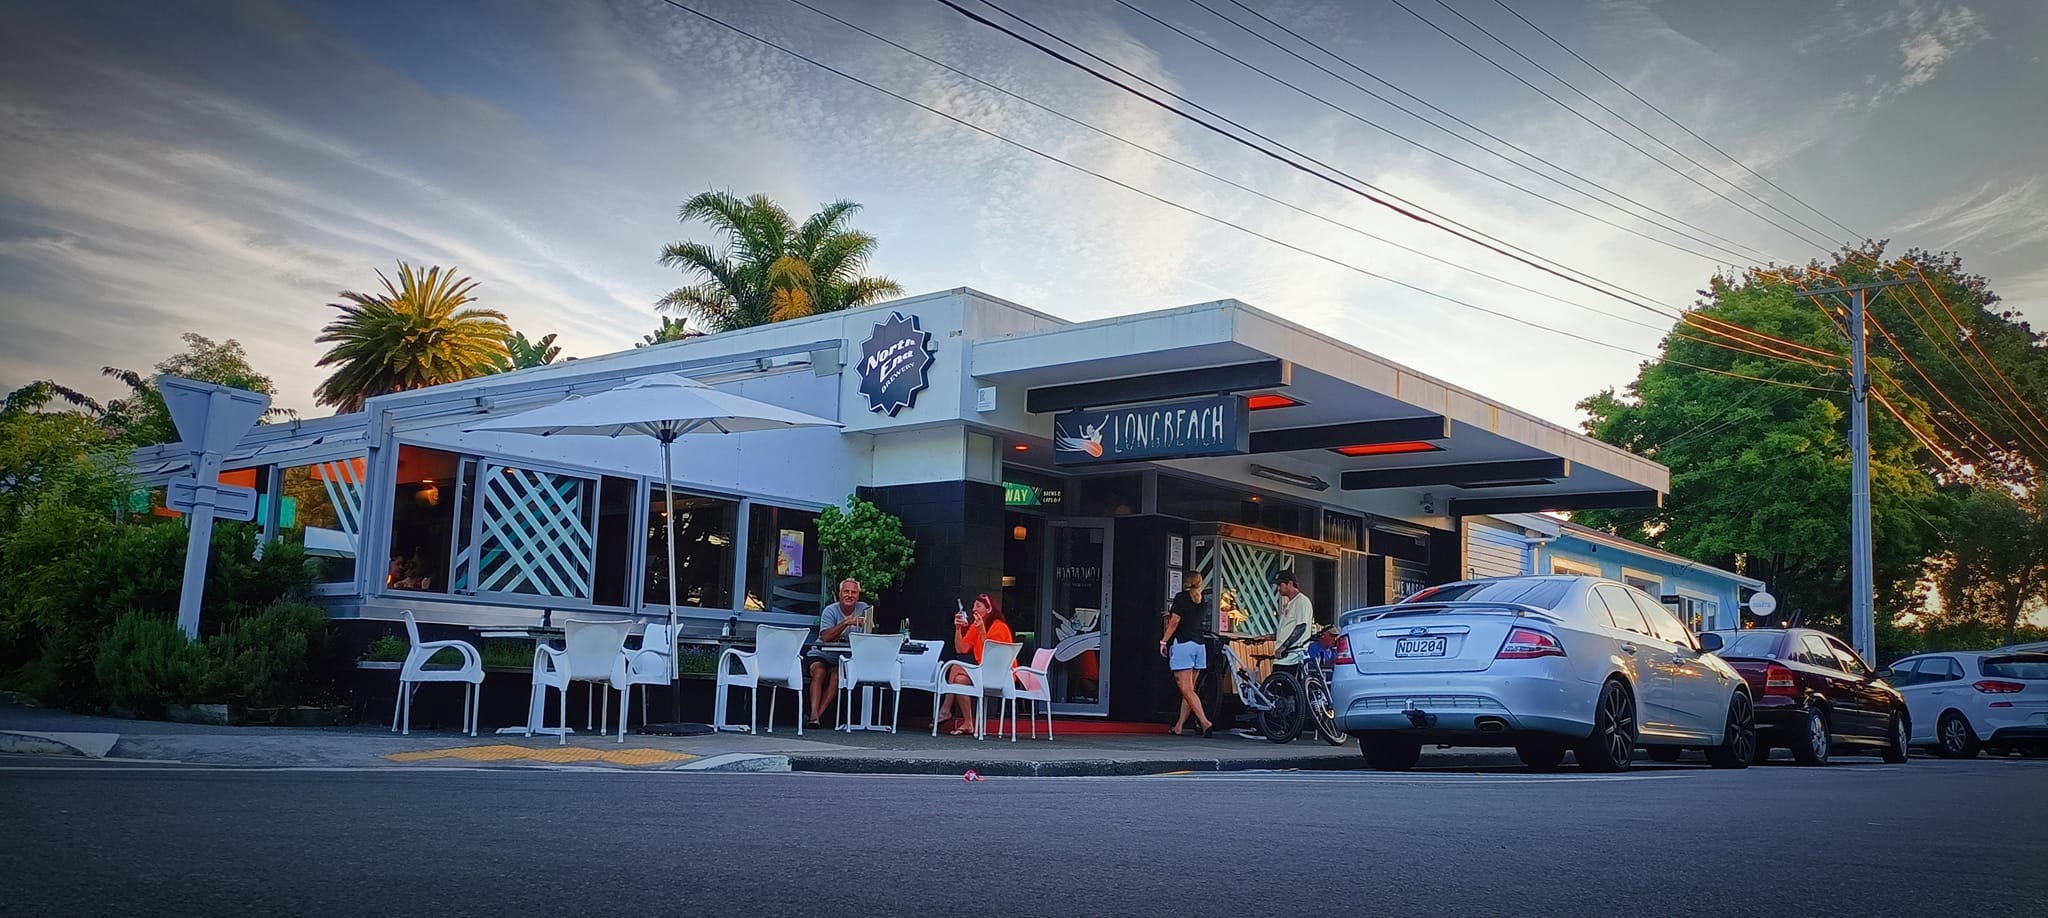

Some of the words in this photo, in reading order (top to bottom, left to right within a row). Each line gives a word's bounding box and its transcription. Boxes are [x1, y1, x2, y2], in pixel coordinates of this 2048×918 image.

[866, 338, 916, 376] North
[880, 350, 914, 383] End
[881, 361, 915, 394] BREWERY
[1114, 405, 1224, 453] LONGBEACH
[1005, 489, 1028, 502] WAY
[1327, 515, 1358, 550] TAVERN
[1397, 640, 1443, 653] NDU204
